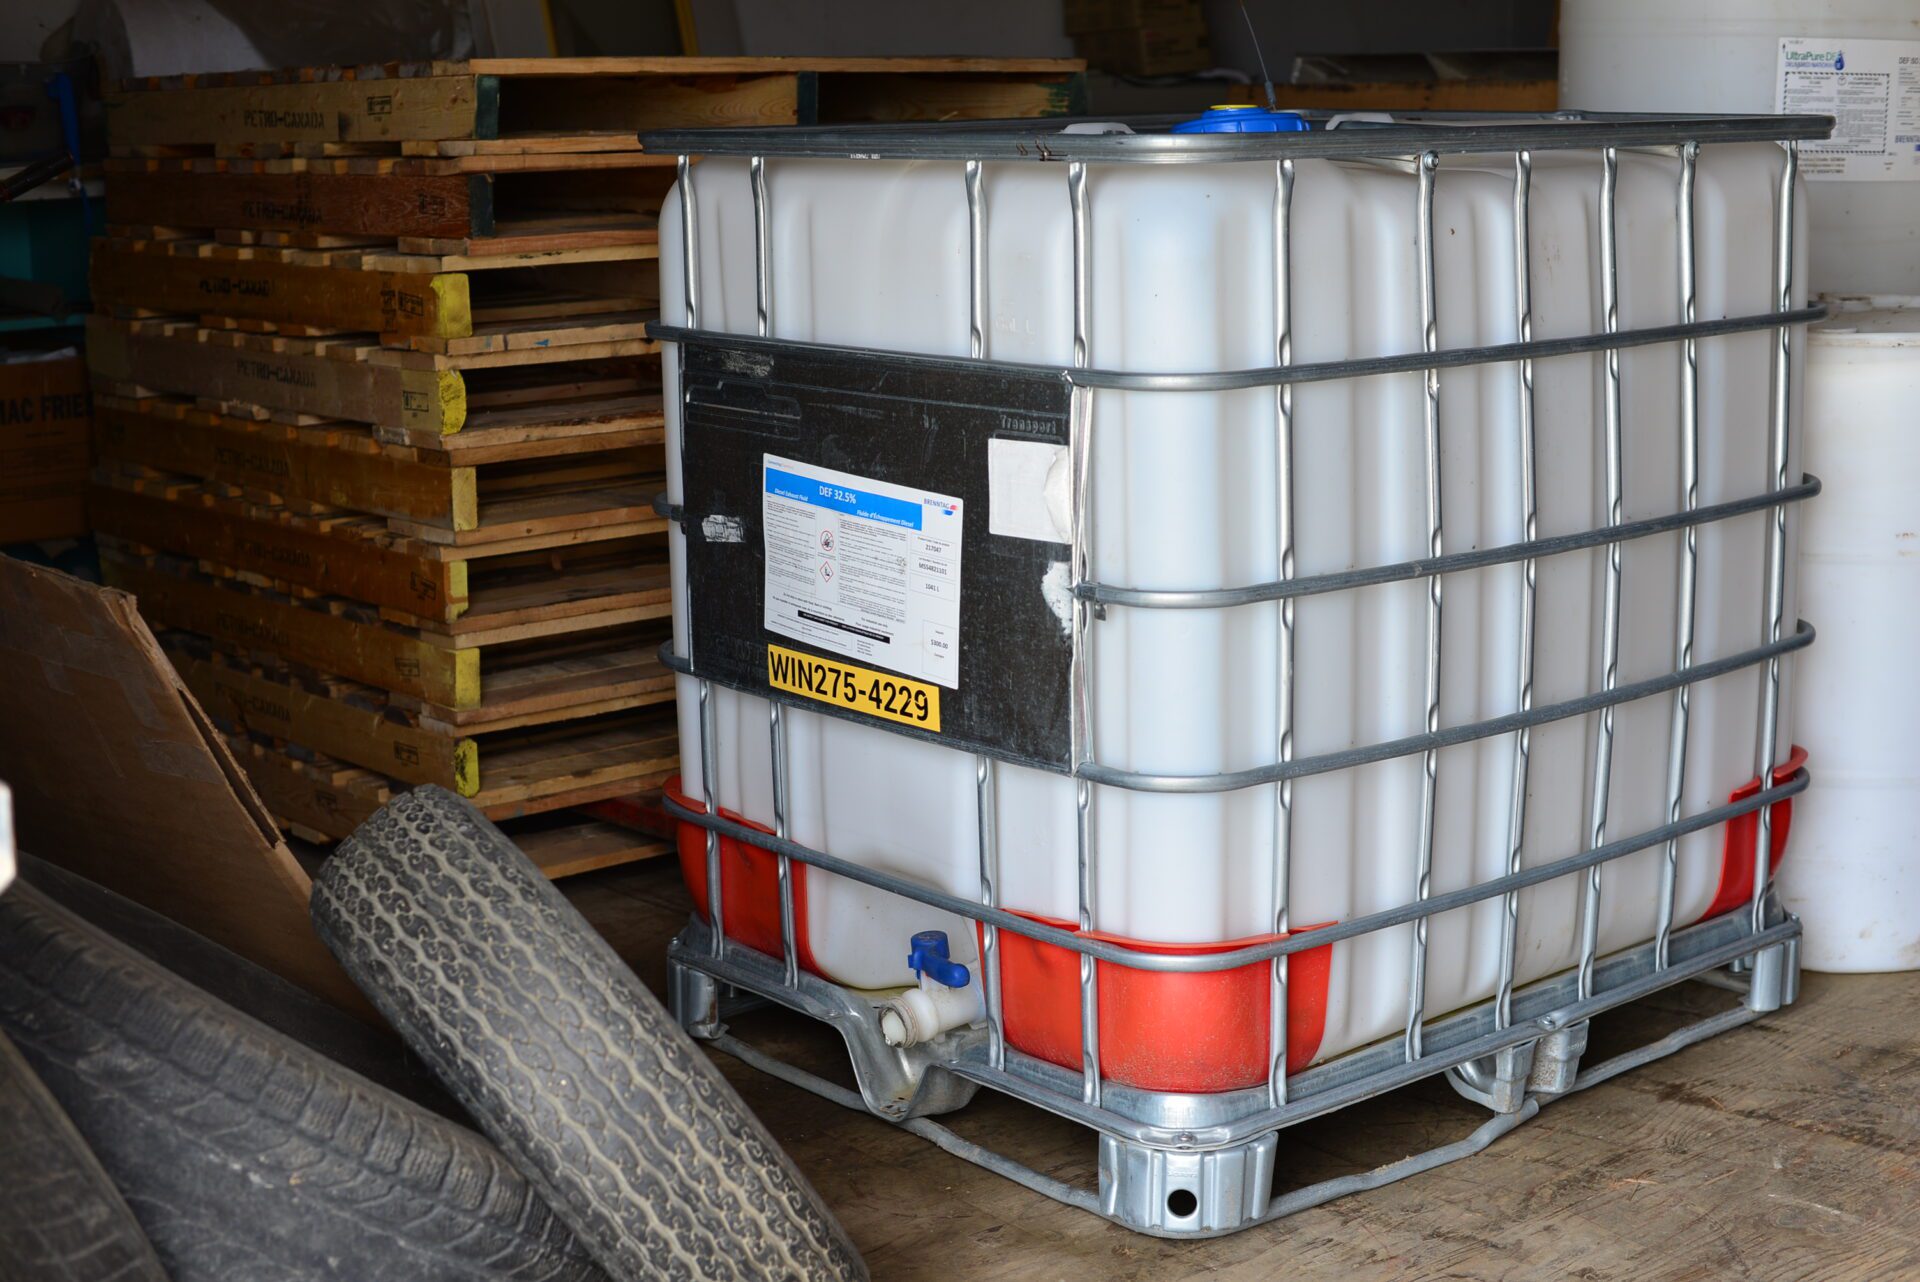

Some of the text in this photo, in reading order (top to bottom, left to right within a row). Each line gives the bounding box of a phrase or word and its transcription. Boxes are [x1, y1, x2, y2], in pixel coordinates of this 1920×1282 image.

[243, 109, 325, 129] PETRO-CANADA
[237, 359, 317, 389] PETRO-CANADA
[819, 485, 857, 505] DEF 32.5%
[924, 497, 950, 510] BRENNTAG
[770, 651, 929, 722] WIN275-4229
